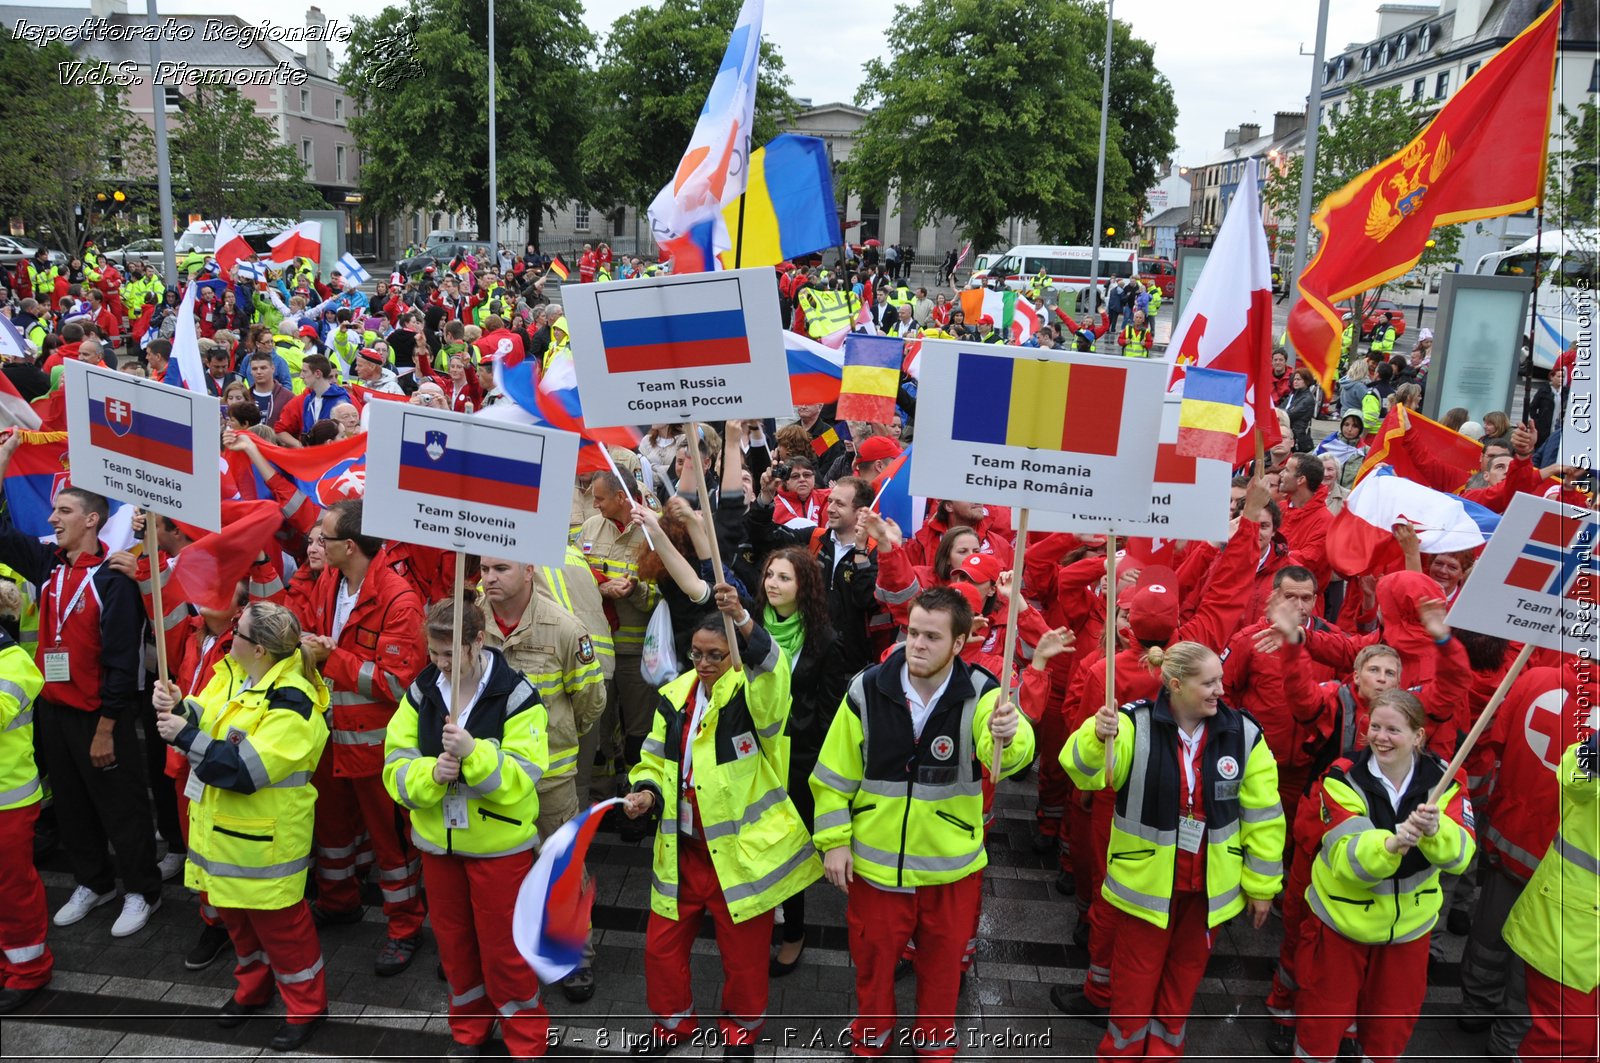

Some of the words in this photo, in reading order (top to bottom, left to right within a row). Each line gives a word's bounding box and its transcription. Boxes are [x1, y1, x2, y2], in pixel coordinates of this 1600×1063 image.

[637, 381, 676, 392] Team
[680, 376, 727, 389] Russia
[627, 399, 688, 411] Сборная
[691, 395, 743, 407] России
[102, 458, 132, 476] Team
[135, 469, 183, 492] Slovakia
[972, 454, 1015, 470] Team
[1021, 459, 1092, 478] Romania
[103, 475, 124, 491] Tím
[127, 483, 183, 509] Slovensko
[965, 473, 1018, 490] Echipa
[1023, 479, 1094, 498] România
[416, 503, 453, 519] Team
[458, 510, 516, 530] Slovenia
[413, 518, 450, 534] Team
[454, 526, 517, 547] Slovenija
[1516, 598, 1553, 615] Team
[1506, 613, 1557, 633] Teamet
